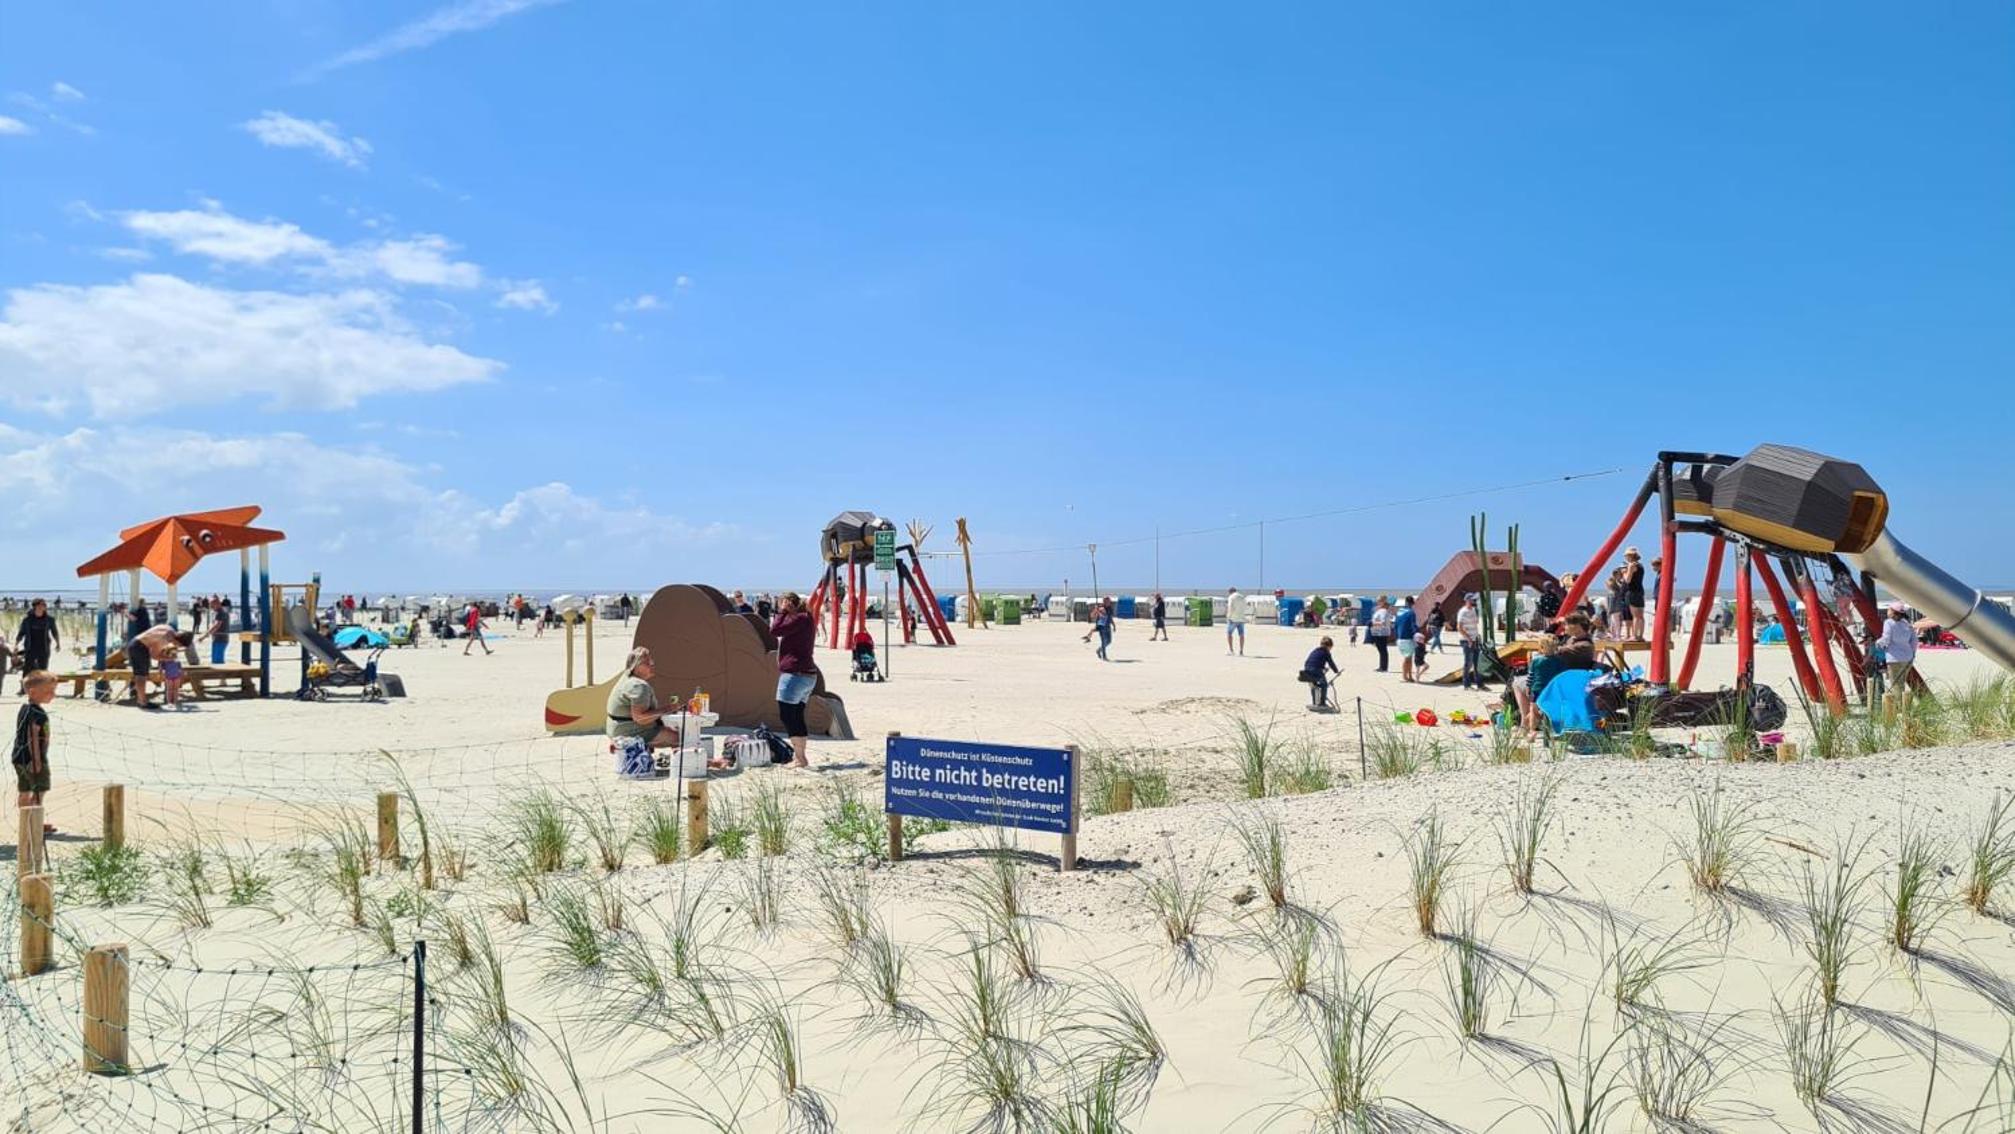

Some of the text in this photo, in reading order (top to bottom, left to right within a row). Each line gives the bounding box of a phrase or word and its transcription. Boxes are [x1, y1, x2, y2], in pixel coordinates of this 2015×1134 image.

[920, 748, 1033, 766] Dünenschutz ist Küstenschutz
[891, 760, 1065, 794] Bitte nicht betreten!
[891, 786, 1064, 813] Nutzen Sie die vorhandenen Dünenüberwege!
